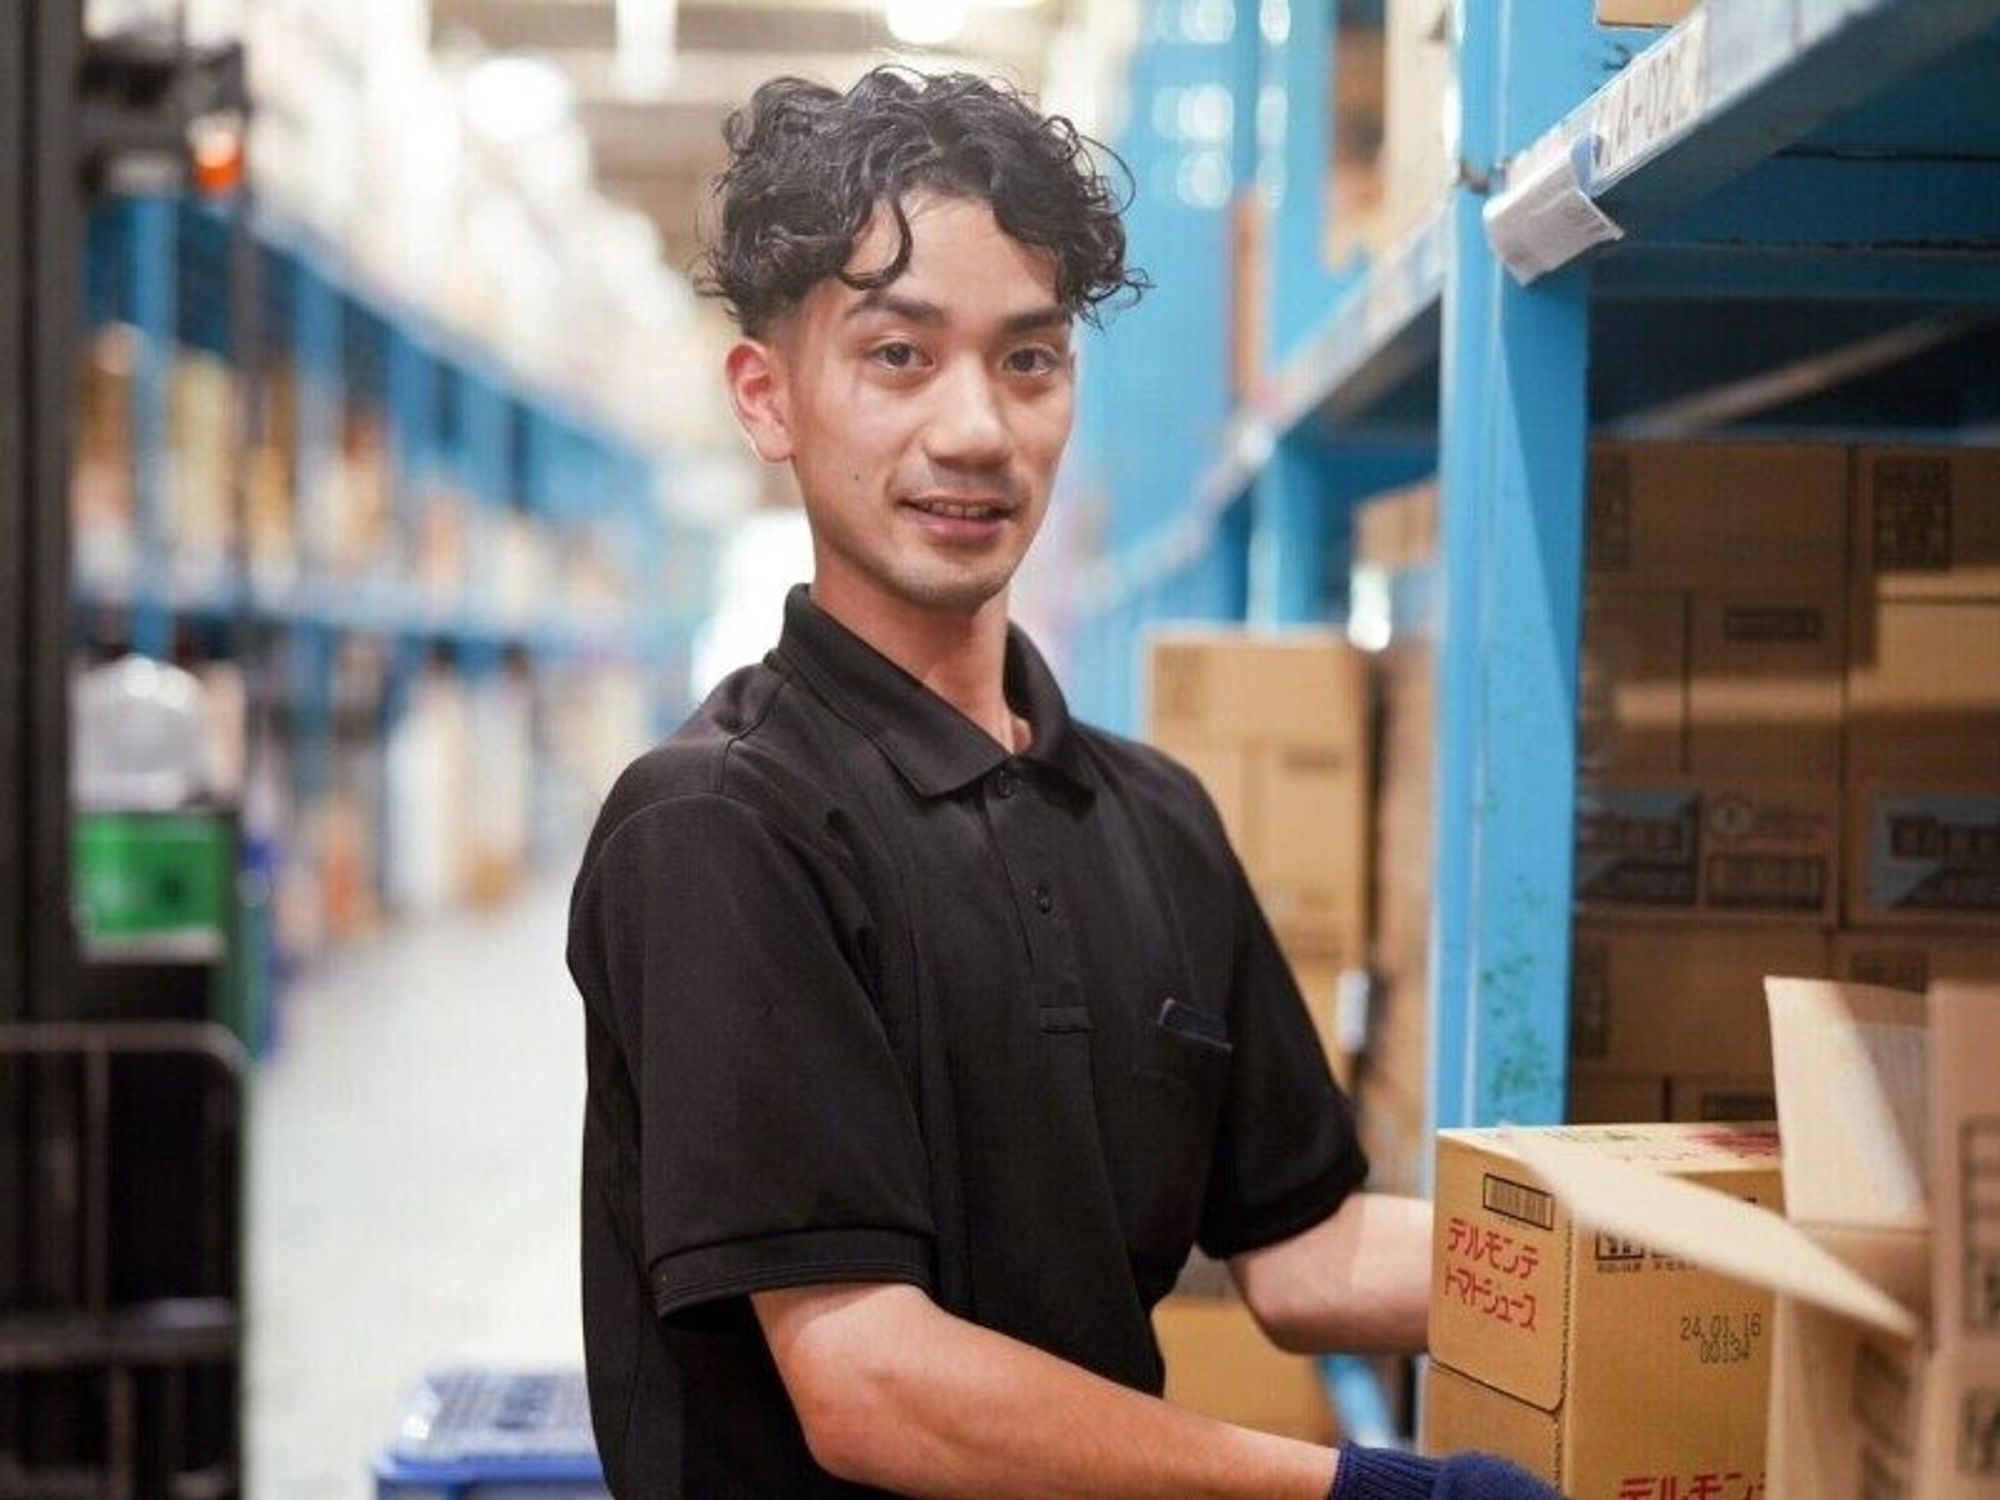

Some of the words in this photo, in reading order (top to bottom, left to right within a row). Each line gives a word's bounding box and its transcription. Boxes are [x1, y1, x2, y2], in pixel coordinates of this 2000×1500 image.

[1447, 1217, 1539, 1279] デルモンテ
[1619, 1471, 1766, 1500] デルモン
